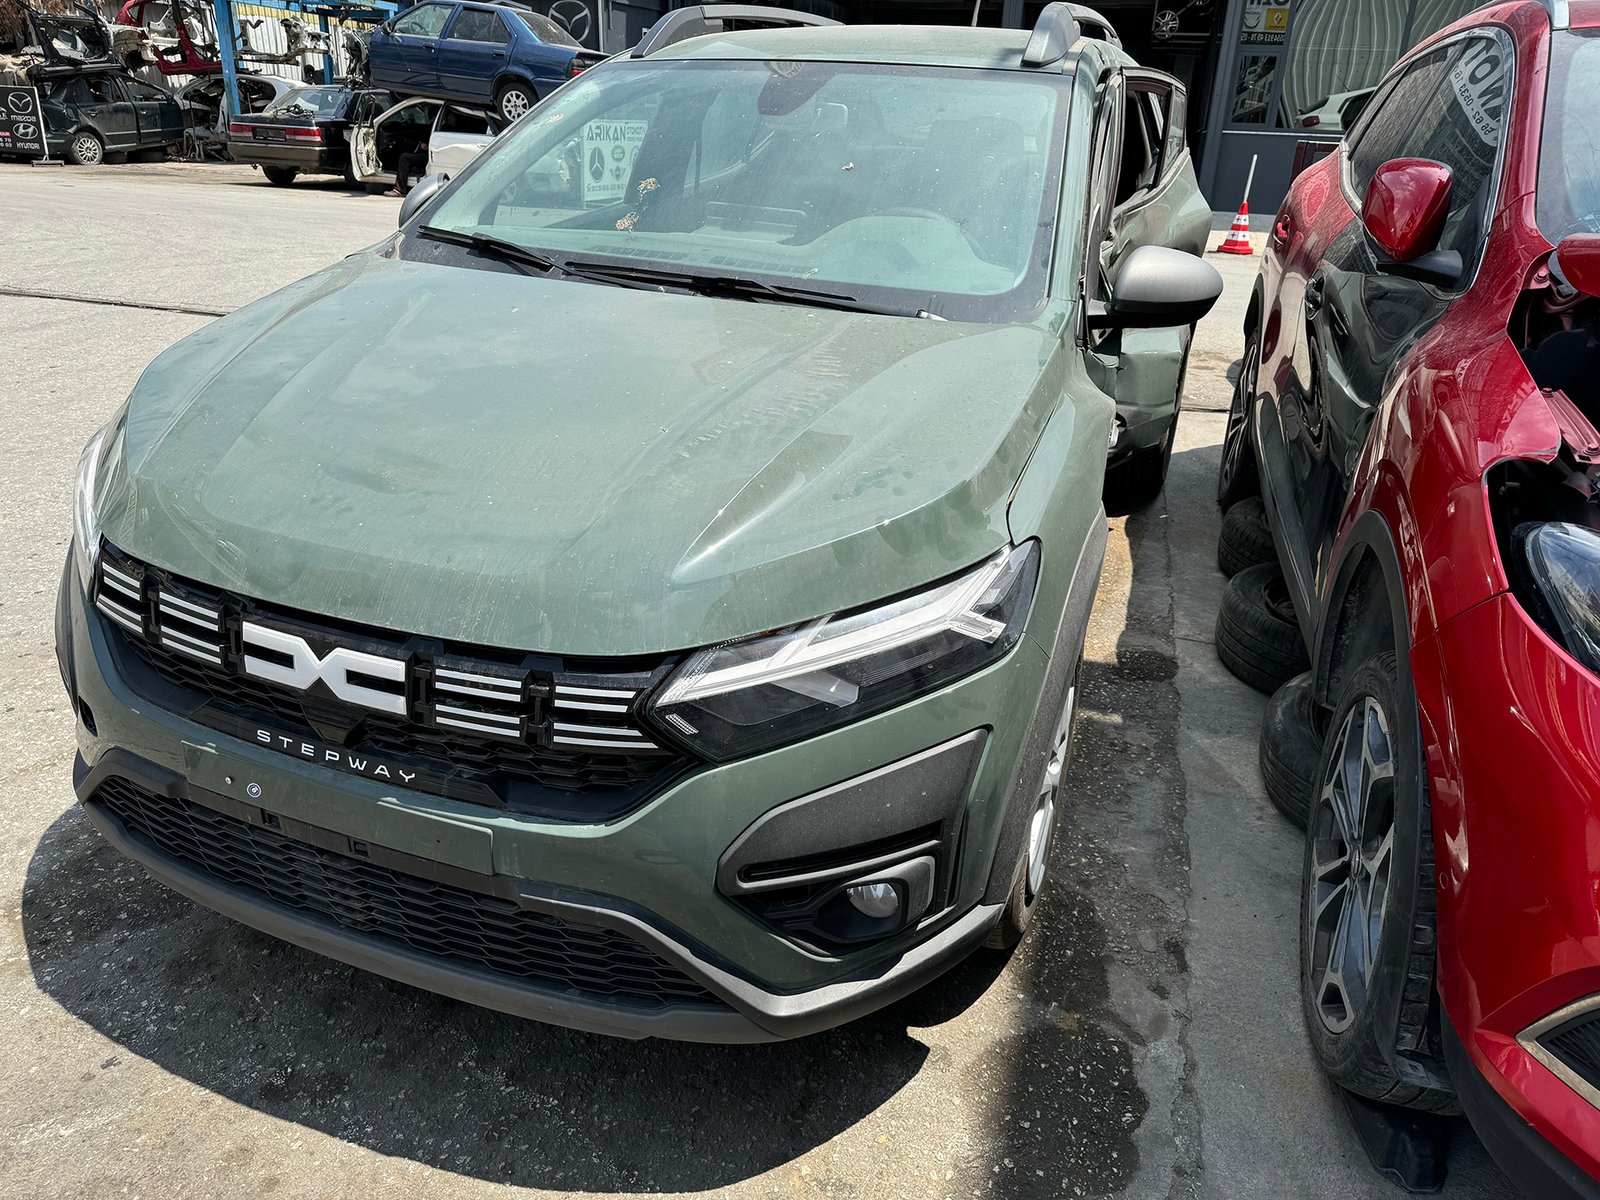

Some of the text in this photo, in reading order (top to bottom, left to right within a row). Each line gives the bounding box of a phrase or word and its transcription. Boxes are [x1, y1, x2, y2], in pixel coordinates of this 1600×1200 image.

[587, 125, 626, 141] ARIKAN
[16, 142, 40, 150] HYUNDAI
[256, 729, 416, 783] STEPWAY
